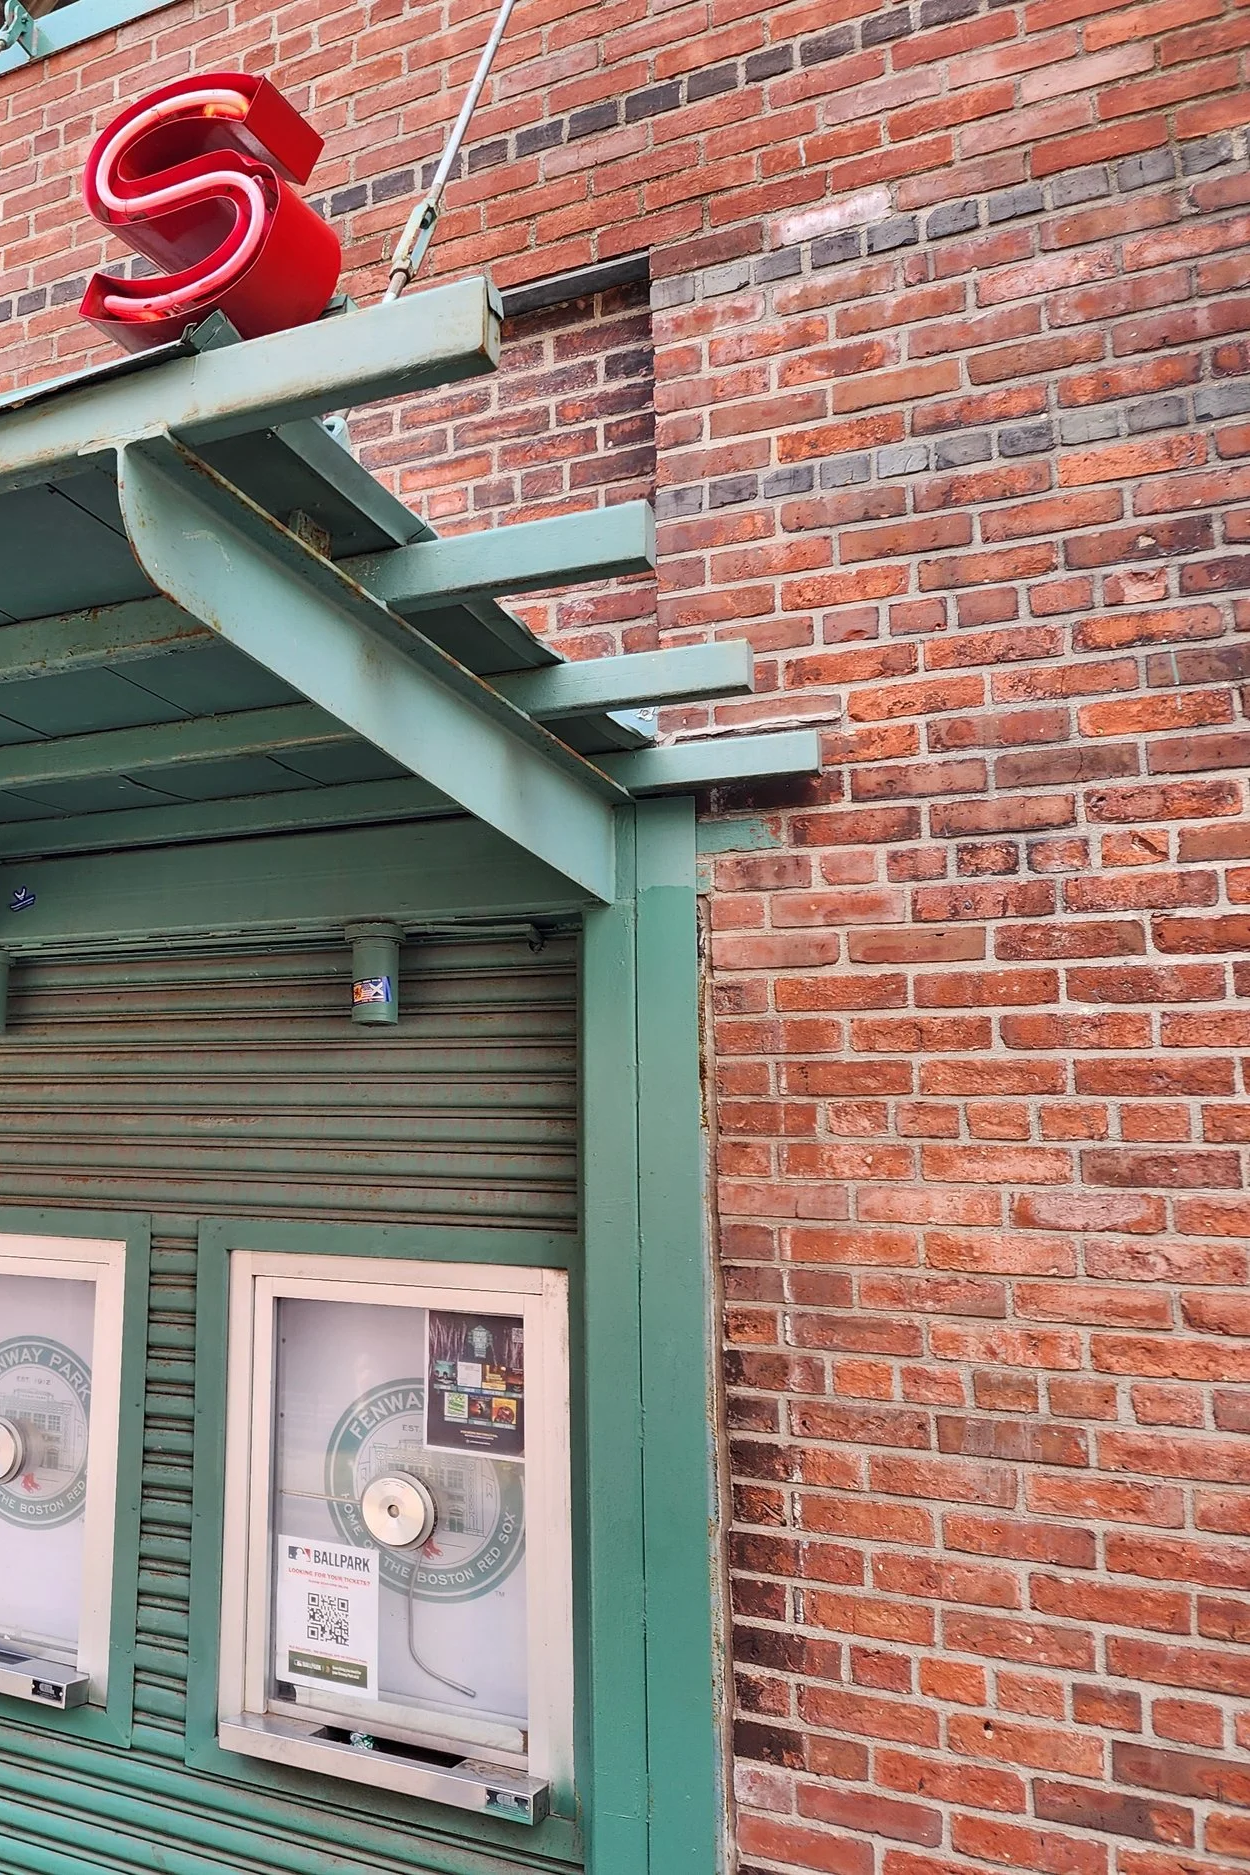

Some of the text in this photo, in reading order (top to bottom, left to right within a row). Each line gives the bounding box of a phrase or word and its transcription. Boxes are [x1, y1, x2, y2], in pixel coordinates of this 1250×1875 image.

[49, 1352, 91, 1402] PARK
[20, 1499, 65, 1515] BOSTON
[66, 1480, 86, 1503] RED
[313, 1549, 371, 1573] BALLPARK
[383, 1555, 411, 1578] THE
[417, 1566, 475, 1586] BOSTON
[476, 1546, 501, 1573] RED
[499, 1511, 517, 1545] SOX
[288, 1567, 313, 1577] LOOKING
[327, 1574, 343, 1582] YOUR
[344, 1577, 371, 1587] TICKETS?
